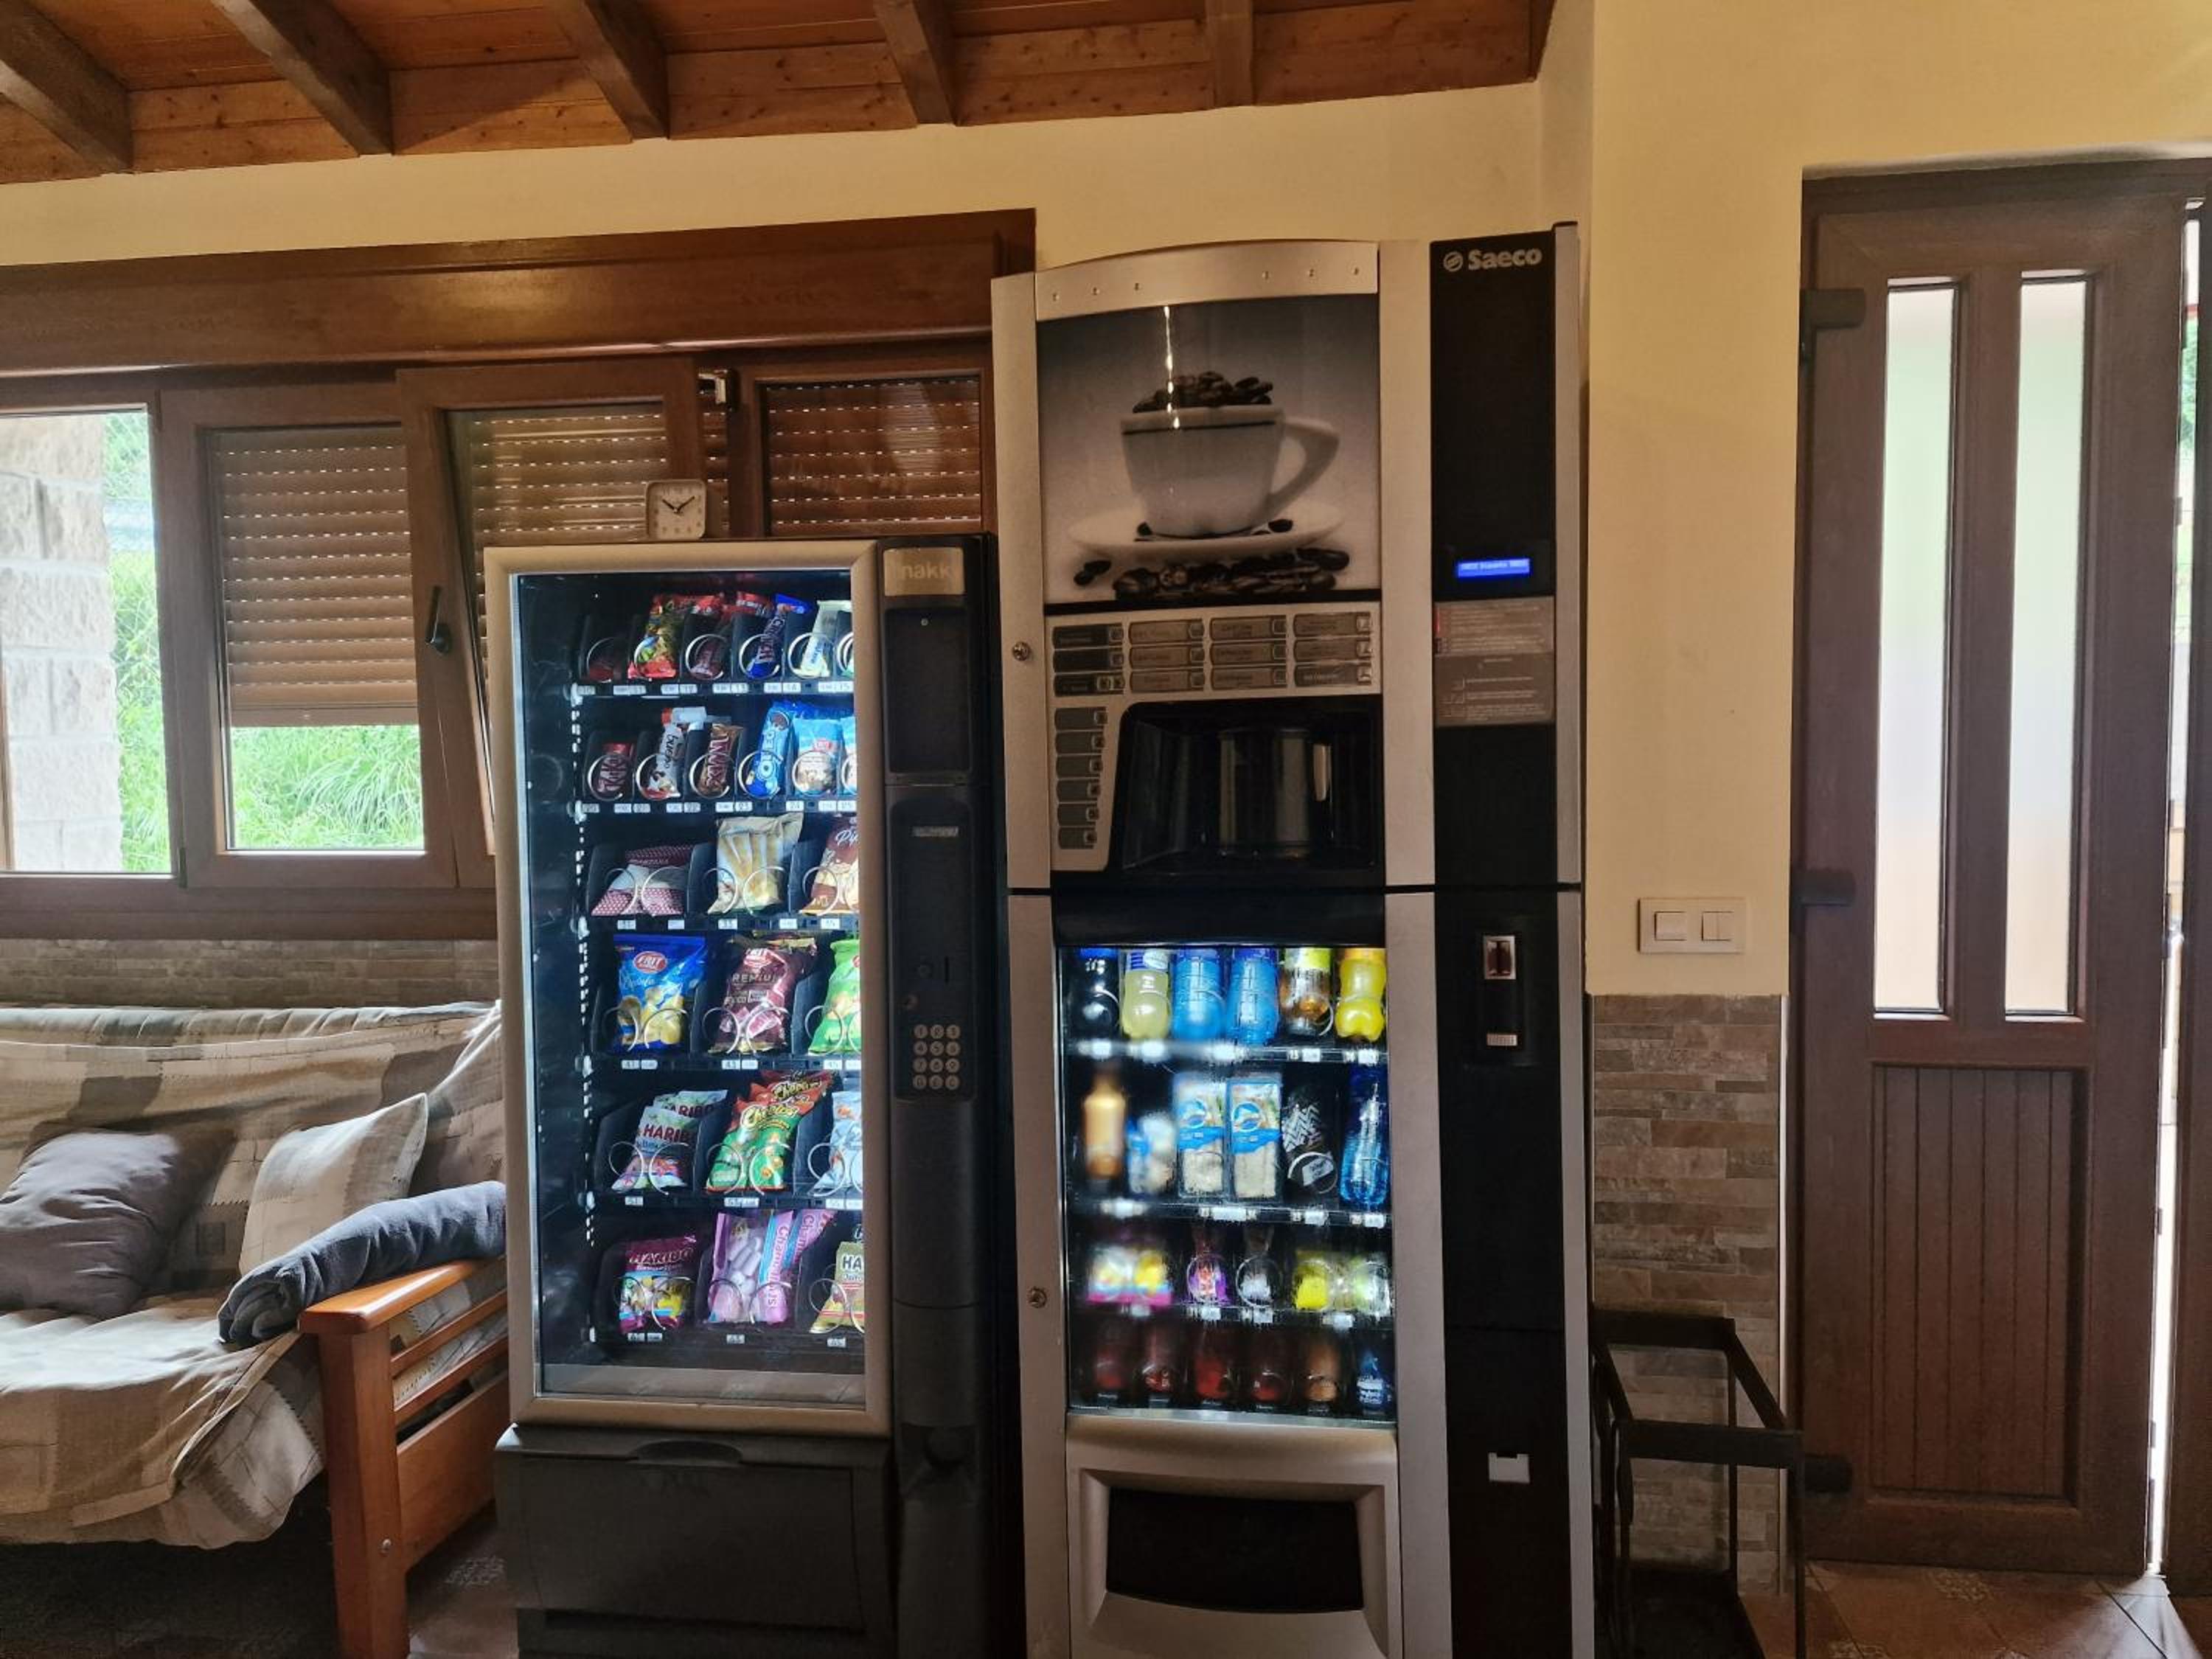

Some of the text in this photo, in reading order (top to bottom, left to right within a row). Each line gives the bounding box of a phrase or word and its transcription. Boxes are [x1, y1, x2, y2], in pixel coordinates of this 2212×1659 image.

[1468, 248, 1543, 271] Saeco
[664, 734, 680, 769] bueno
[664, 1105, 714, 1119] ARIBO
[843, 1255, 862, 1269] HA
